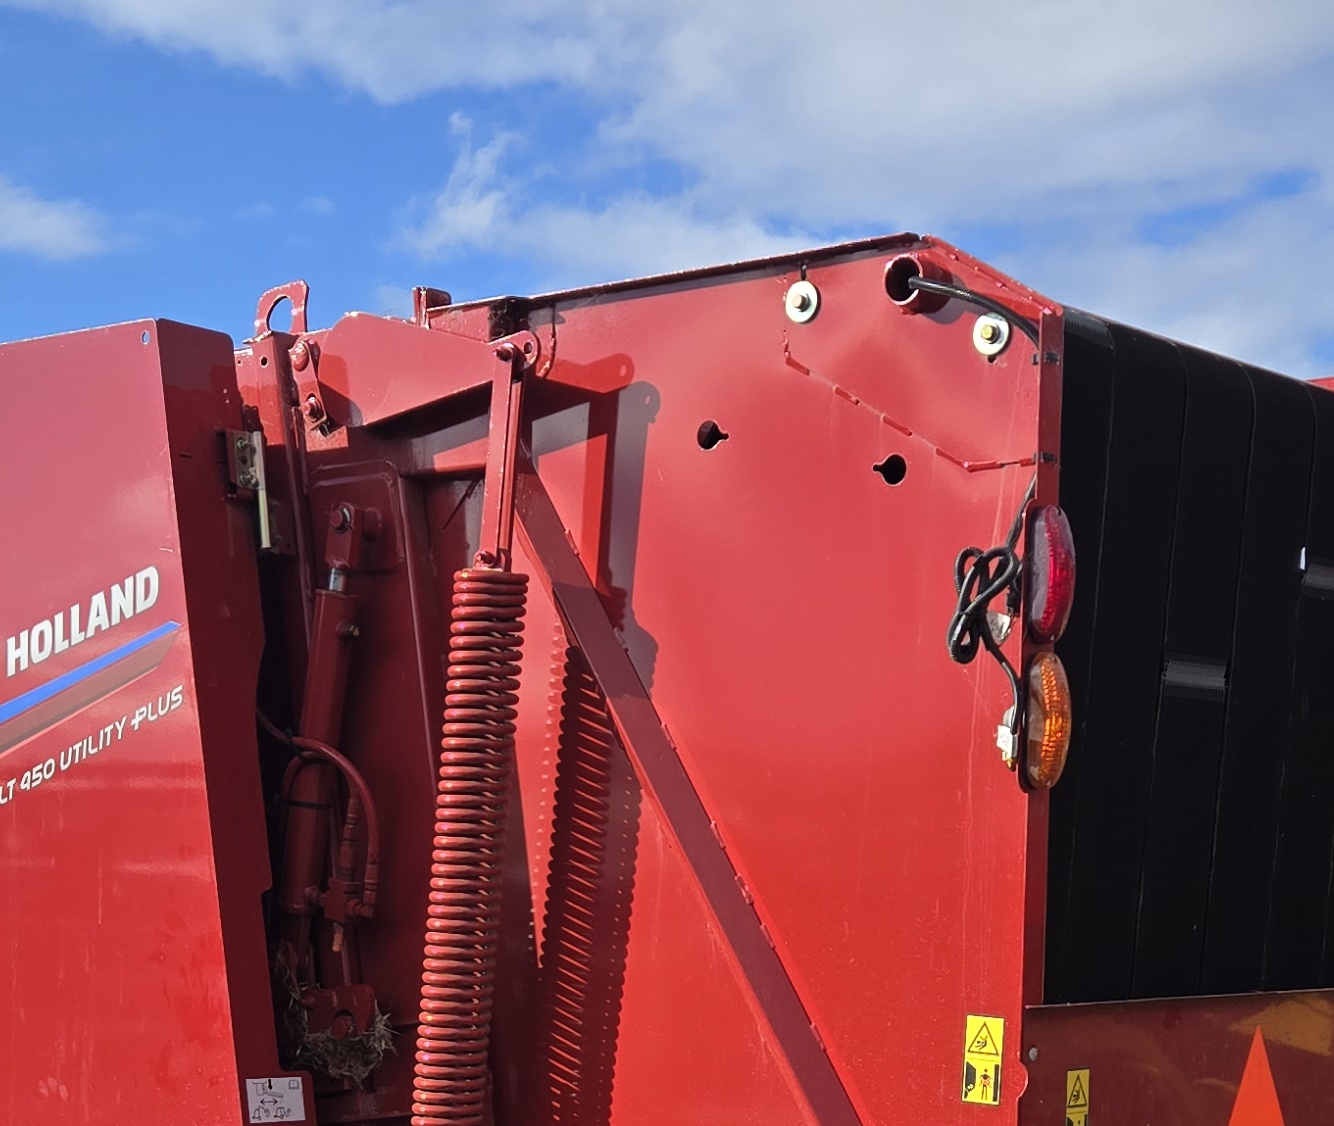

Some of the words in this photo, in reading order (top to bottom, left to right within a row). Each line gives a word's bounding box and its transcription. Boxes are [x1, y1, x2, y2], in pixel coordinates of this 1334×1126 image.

[6, 565, 160, 680] HOLLAND
[19, 756, 57, 792] 450
[58, 716, 129, 773] UTILITY
